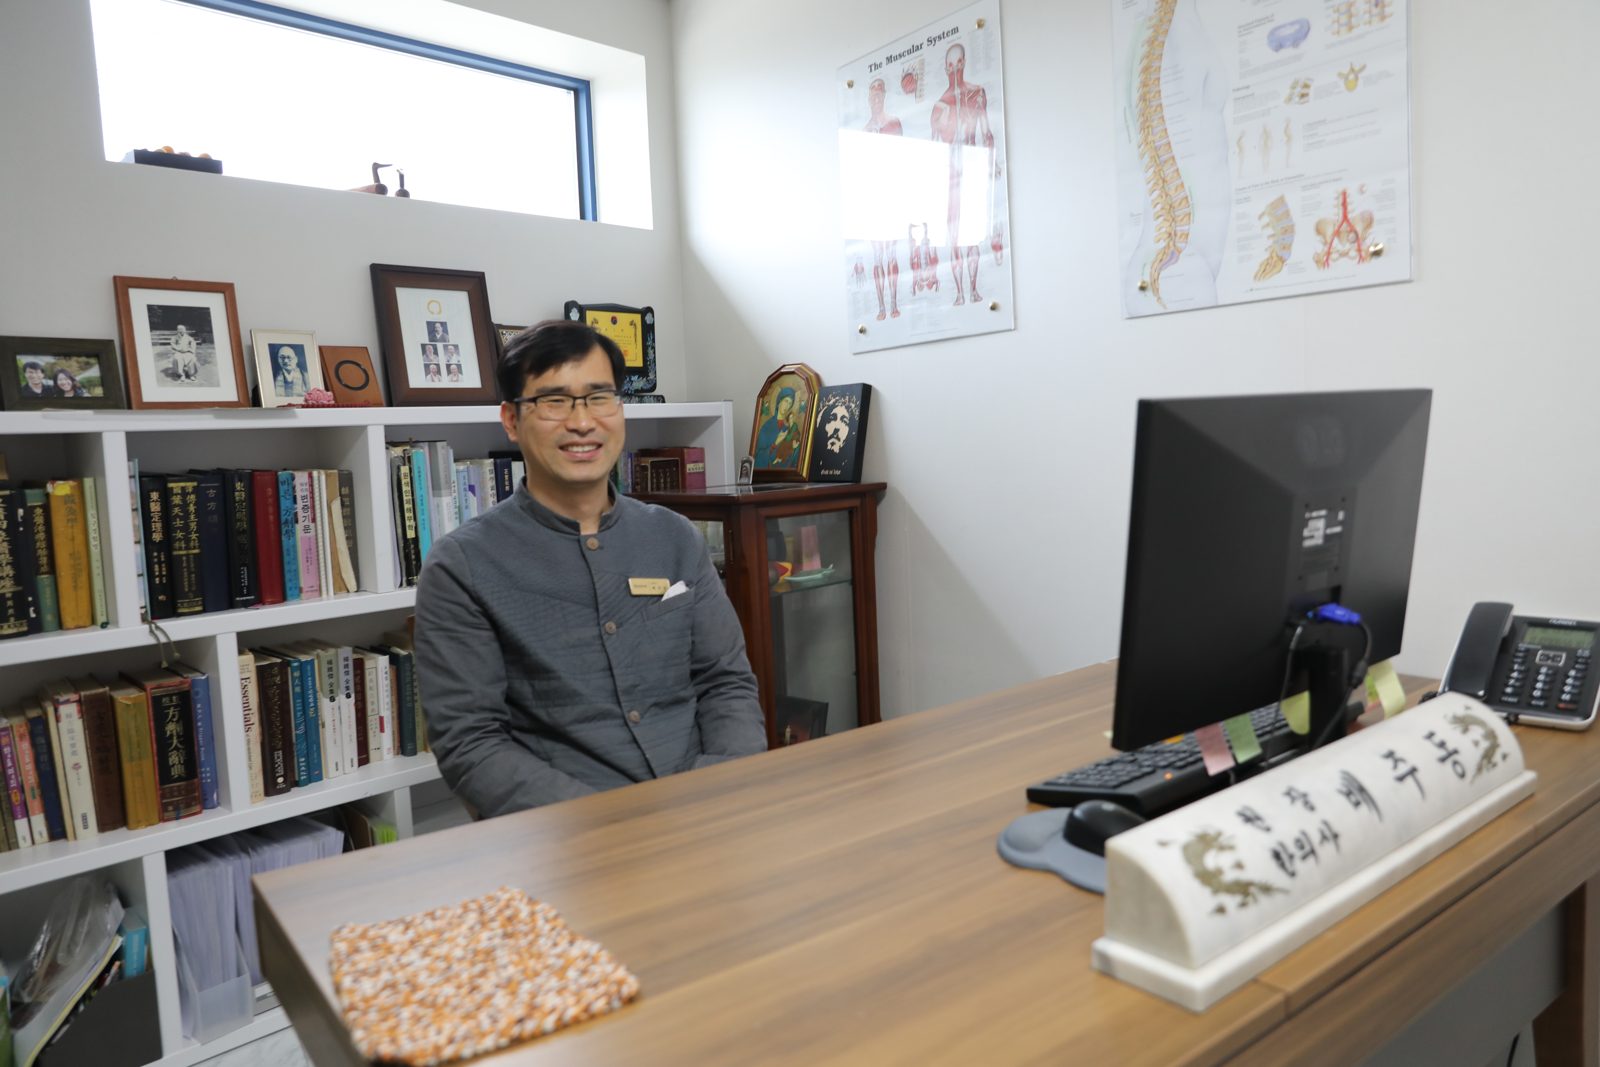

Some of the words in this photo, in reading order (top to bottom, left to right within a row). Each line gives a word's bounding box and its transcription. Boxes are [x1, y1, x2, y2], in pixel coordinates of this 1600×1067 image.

[868, 62, 883, 73] The
[886, 42, 924, 65] Muscular
[926, 26, 959, 46] System
[239, 675, 255, 733] Essentials
